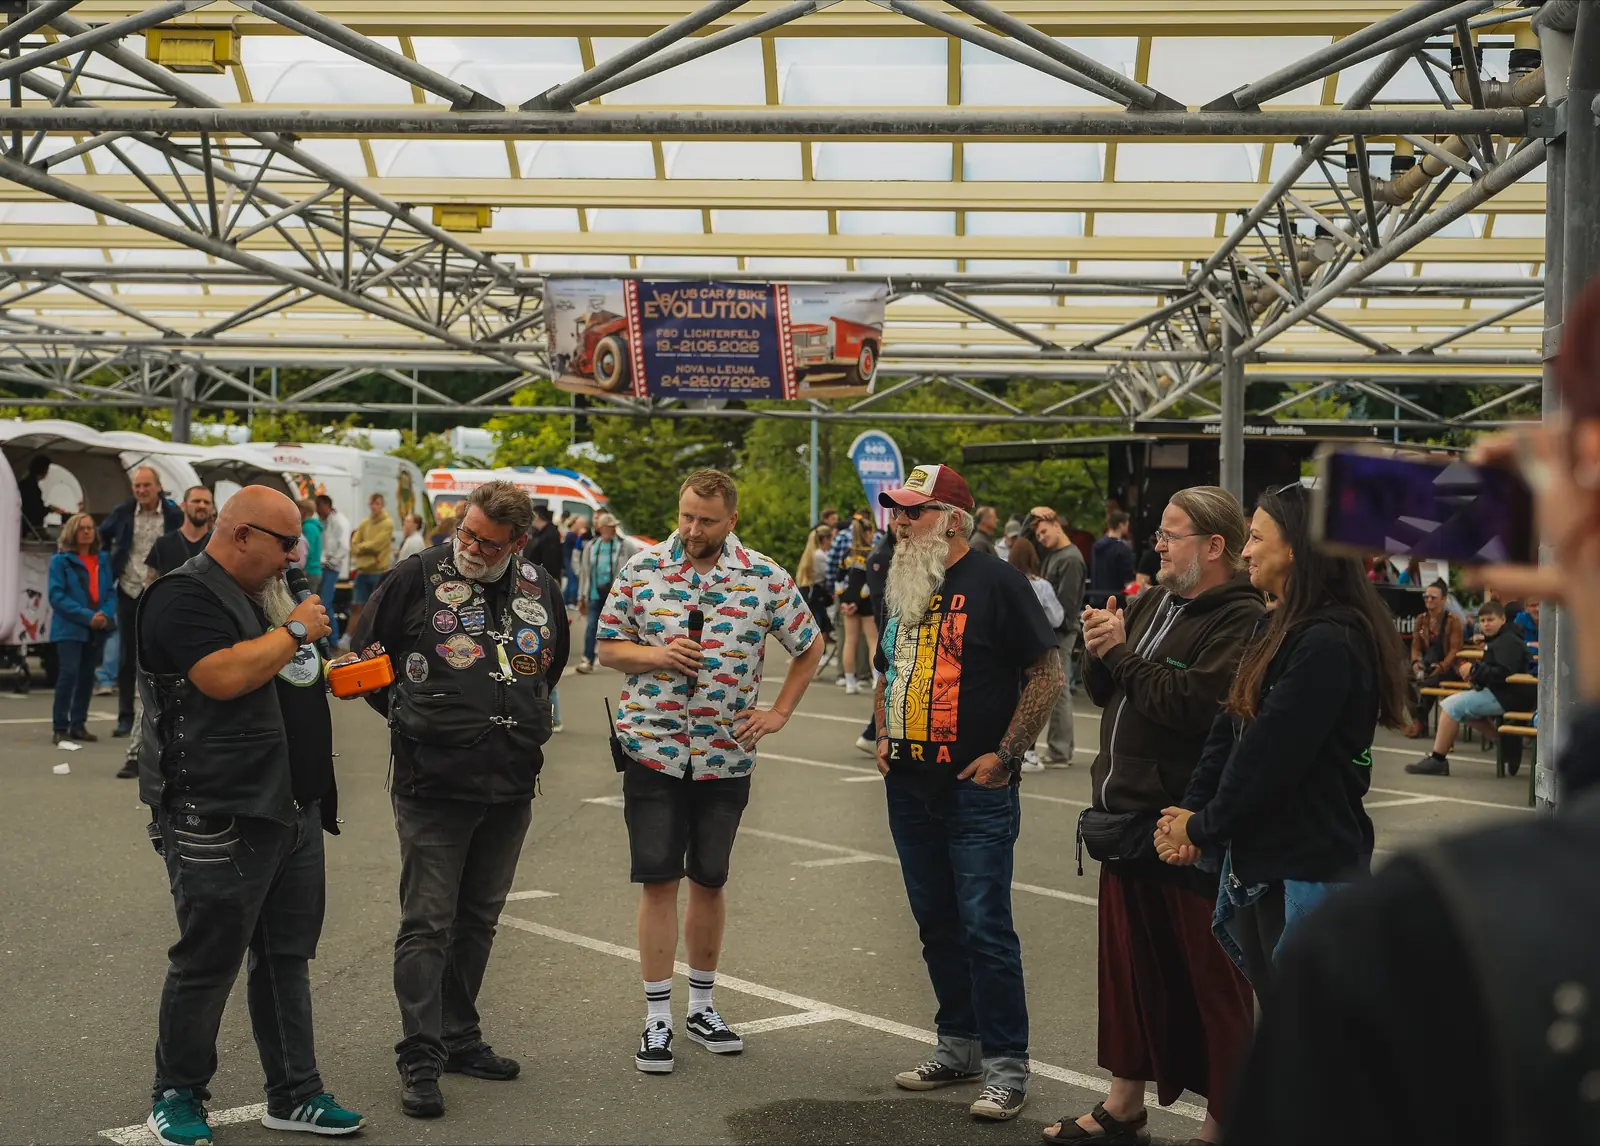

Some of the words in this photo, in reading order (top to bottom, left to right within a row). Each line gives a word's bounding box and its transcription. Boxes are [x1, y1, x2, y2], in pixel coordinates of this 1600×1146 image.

[680, 289, 698, 299] US
[699, 289, 724, 299] CAR
[737, 289, 767, 300] BIKE
[644, 290, 767, 319] EVOLUTION
[683, 329, 760, 339] LICHTERFELD
[675, 364, 705, 373] NOVA
[717, 365, 755, 374] LEUNA
[1242, 424, 1265, 434] ritzer
